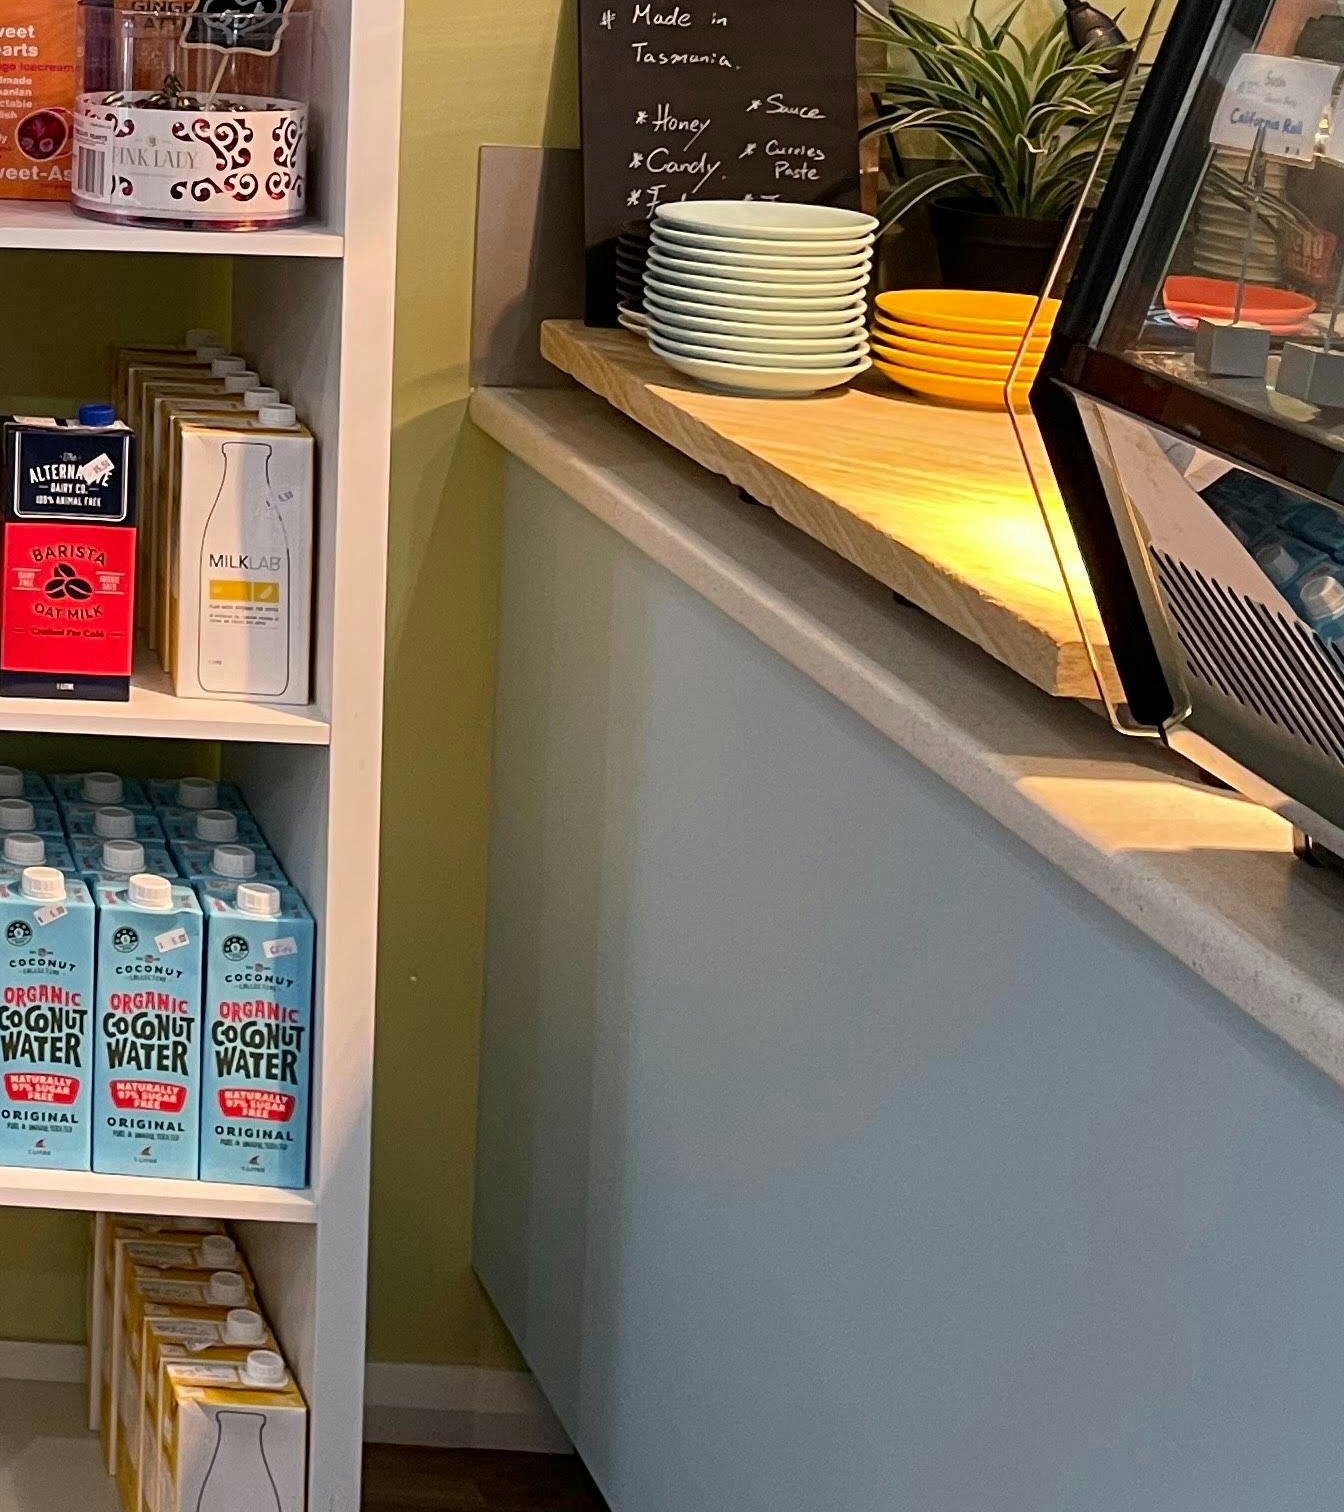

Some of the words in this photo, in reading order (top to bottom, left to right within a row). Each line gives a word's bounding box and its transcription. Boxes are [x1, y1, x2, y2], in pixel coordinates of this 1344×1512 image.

[632, 5, 691, 27] Made
[712, 13, 727, 27] in
[766, 94, 826, 119] Sauce
[652, 104, 710, 151] Honey
[154, 149, 197, 170] LADY
[775, 161, 820, 180] Paste
[51, 483, 72, 493] DAIRY
[32, 545, 106, 566] BARISTA
[210, 554, 281, 571] MILKLAB
[35, 604, 64, 618] OAT
[68, 605, 103, 619] MILK
[9, 959, 76, 971] COCONUT
[116, 966, 183, 979] COCONUT
[225, 974, 294, 987] COCONUT
[4, 985, 82, 1007] ORGANIC
[110, 992, 188, 1014] ORGANIC
[219, 1000, 299, 1023] ORGANIC
[103, 1012, 195, 1043] COCONUT
[212, 1021, 305, 1053] COCONUT
[1, 1031, 81, 1068] WATER
[106, 1038, 188, 1075] WATER
[215, 1046, 298, 1085] WATER
[11, 1075, 72, 1087] NATURALLY
[35, 1085, 70, 1094] SUGAR
[2, 1110, 78, 1123] ORIGINAL
[107, 1117, 185, 1132] ORIGINAL
[215, 1126, 293, 1141] ORIGINAL
